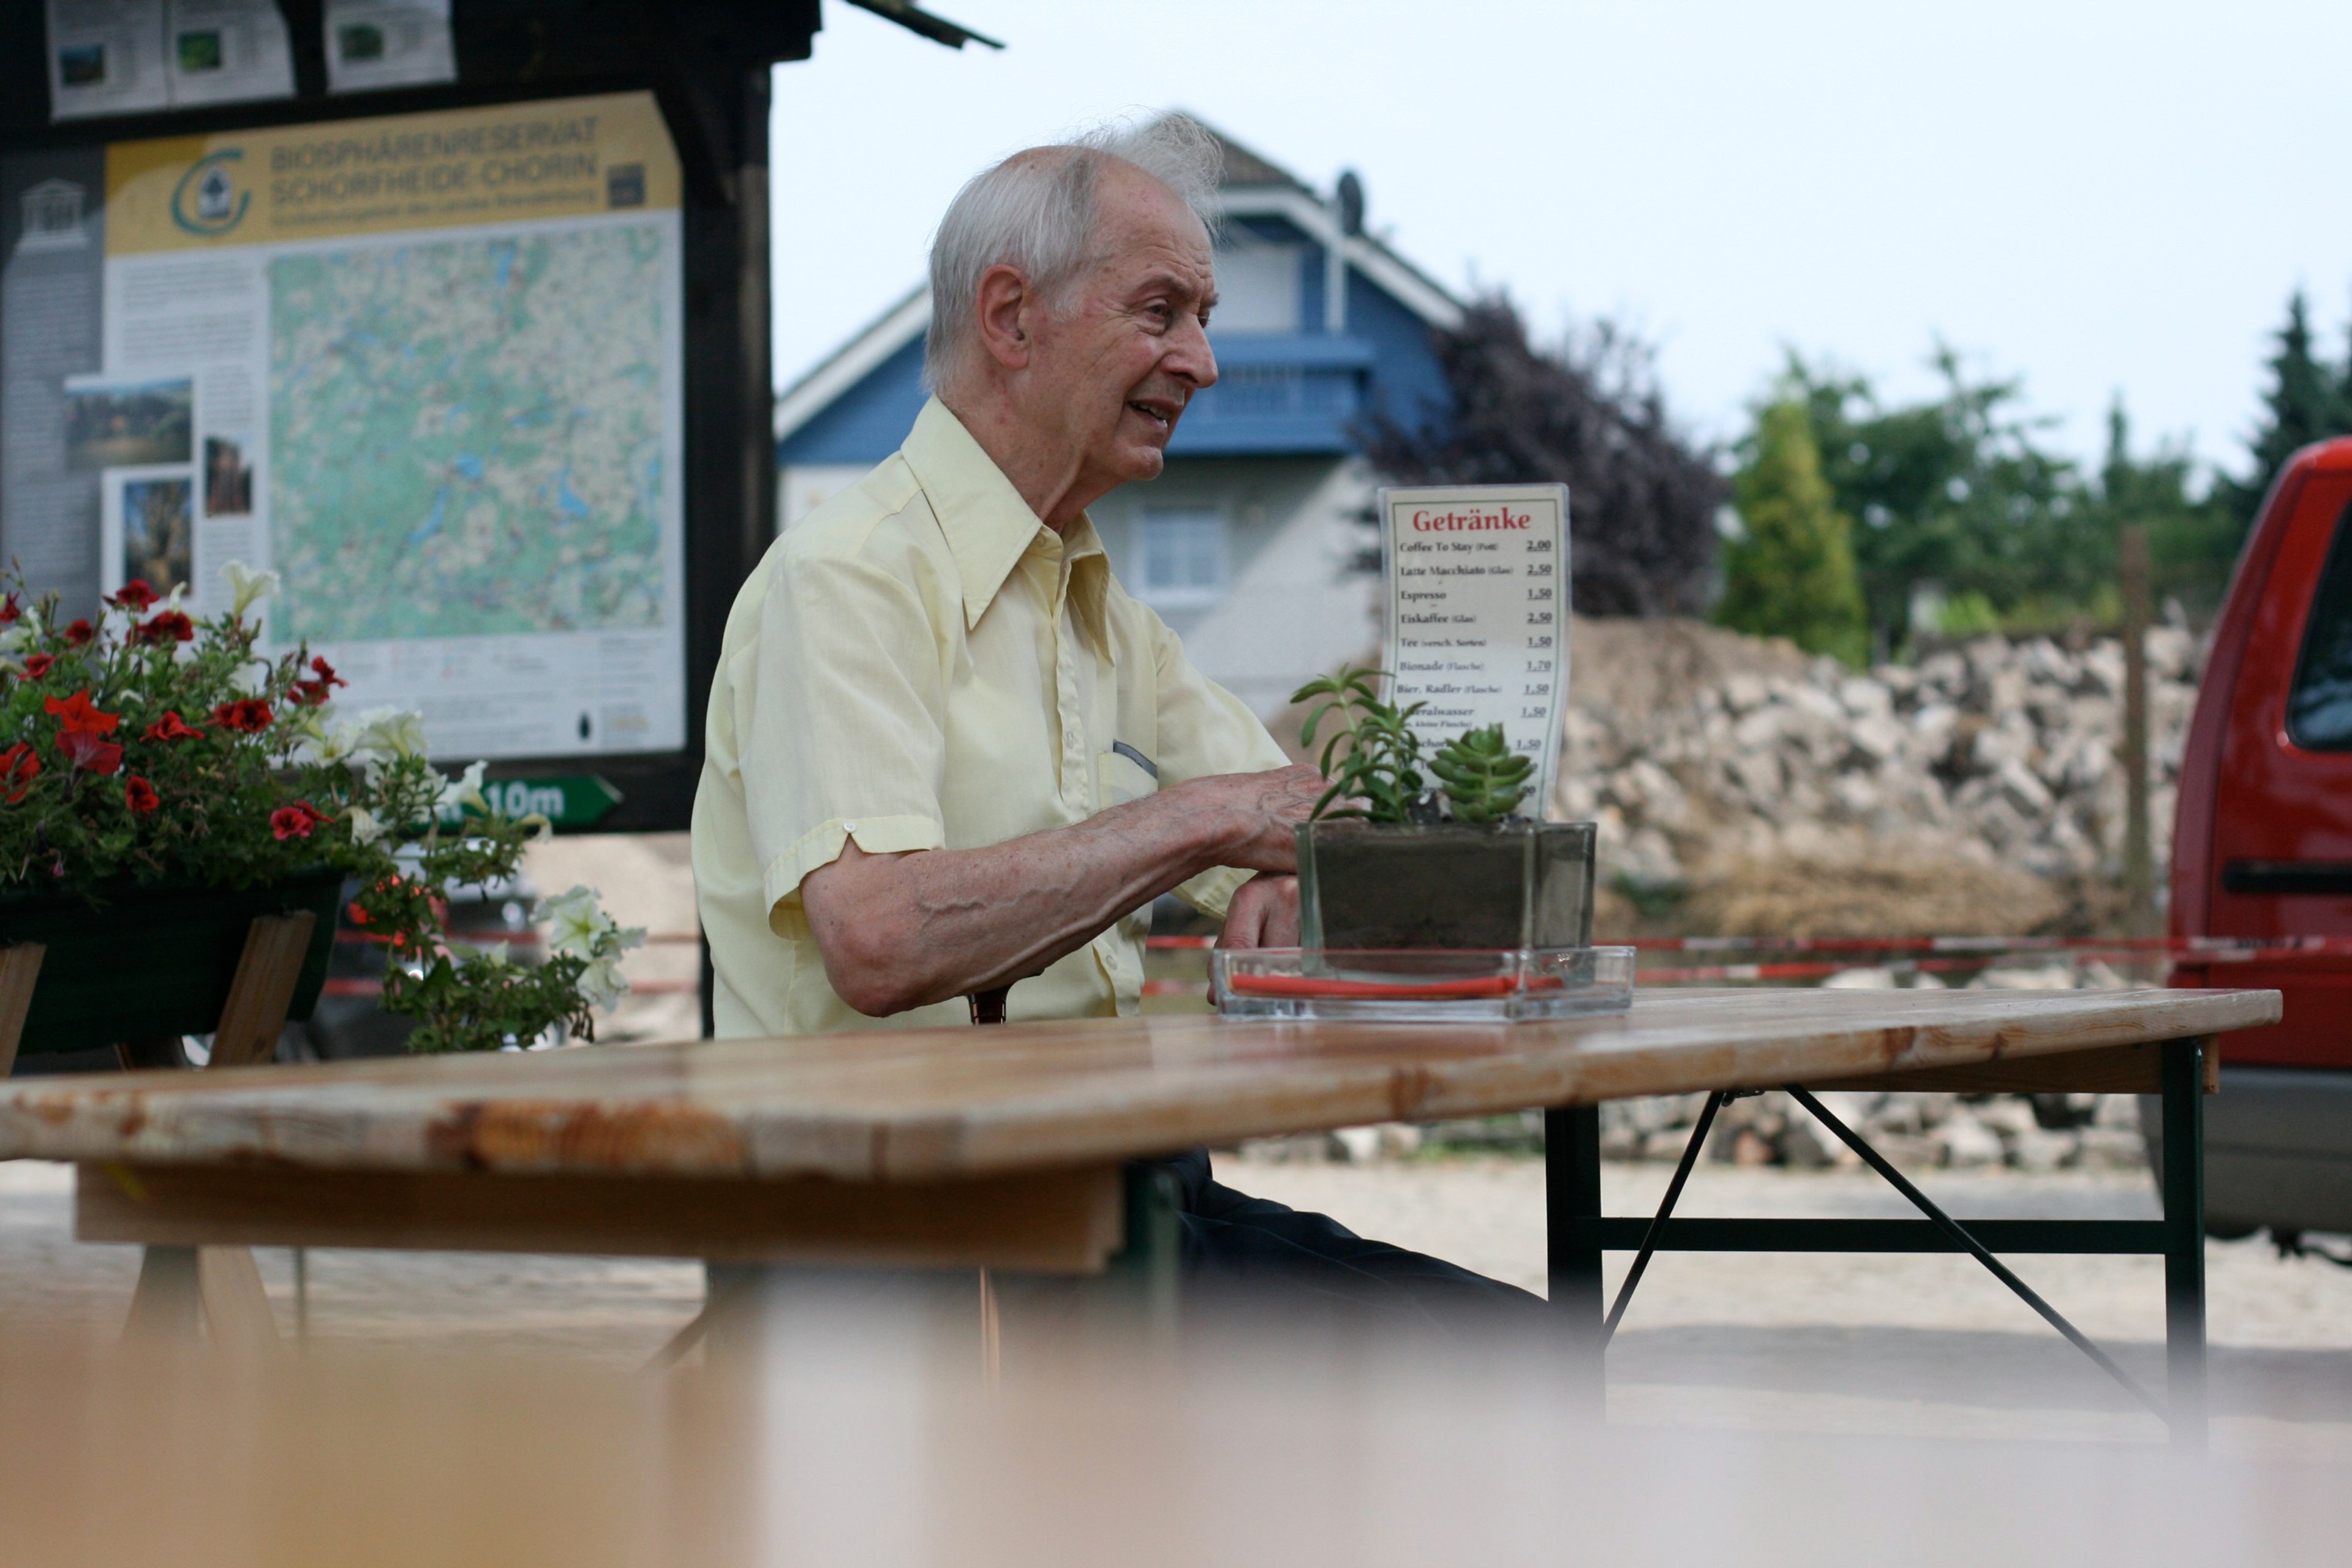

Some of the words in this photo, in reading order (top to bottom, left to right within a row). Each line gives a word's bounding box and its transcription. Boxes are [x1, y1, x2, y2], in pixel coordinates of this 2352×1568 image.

[271, 116, 598, 173] BIOSPHÄRENRESERVAT
[1413, 507, 1531, 532] Getränke
[1400, 541, 1432, 551] Coffee
[1436, 542, 1449, 551] To
[1451, 542, 1472, 554] Stay
[1401, 567, 1425, 575] Latte
[1430, 565, 1485, 575] Macchiato
[1488, 565, 1513, 575] (Glas)
[1401, 590, 1446, 603] Espresso
[1401, 613, 1448, 623] Eiskaffee
[1452, 614, 1476, 623] (Glas)
[1401, 638, 1418, 647] Tee
[1400, 660, 1443, 671] Bionade
[1447, 662, 1484, 671] (Flasche)
[1397, 684, 1422, 693] Bier,
[1426, 684, 1461, 693] Radler
[1464, 685, 1502, 694] (Flasche)
[484, 782, 564, 818] 10m
